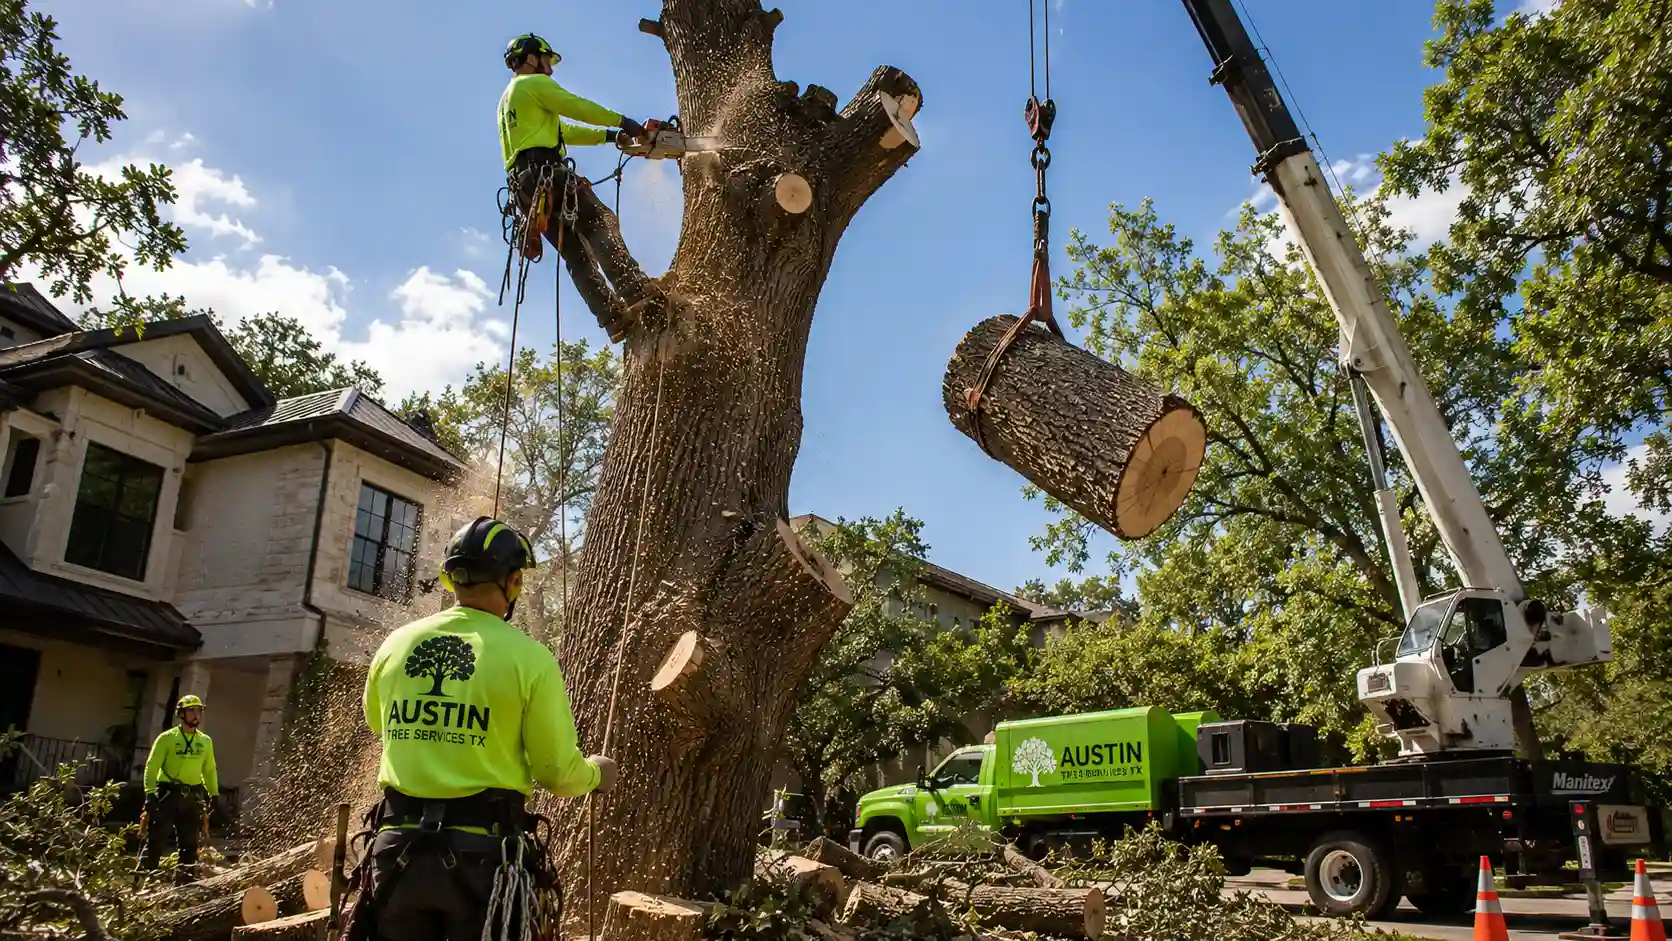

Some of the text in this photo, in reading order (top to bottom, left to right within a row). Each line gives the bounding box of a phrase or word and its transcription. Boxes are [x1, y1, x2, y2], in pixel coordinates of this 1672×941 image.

[388, 700, 490, 732] AUSTIN
[387, 729, 486, 747] TREE SERVICES TX
[1060, 741, 1142, 767] AUSTIN
[1553, 772, 1612, 790] Manitex
